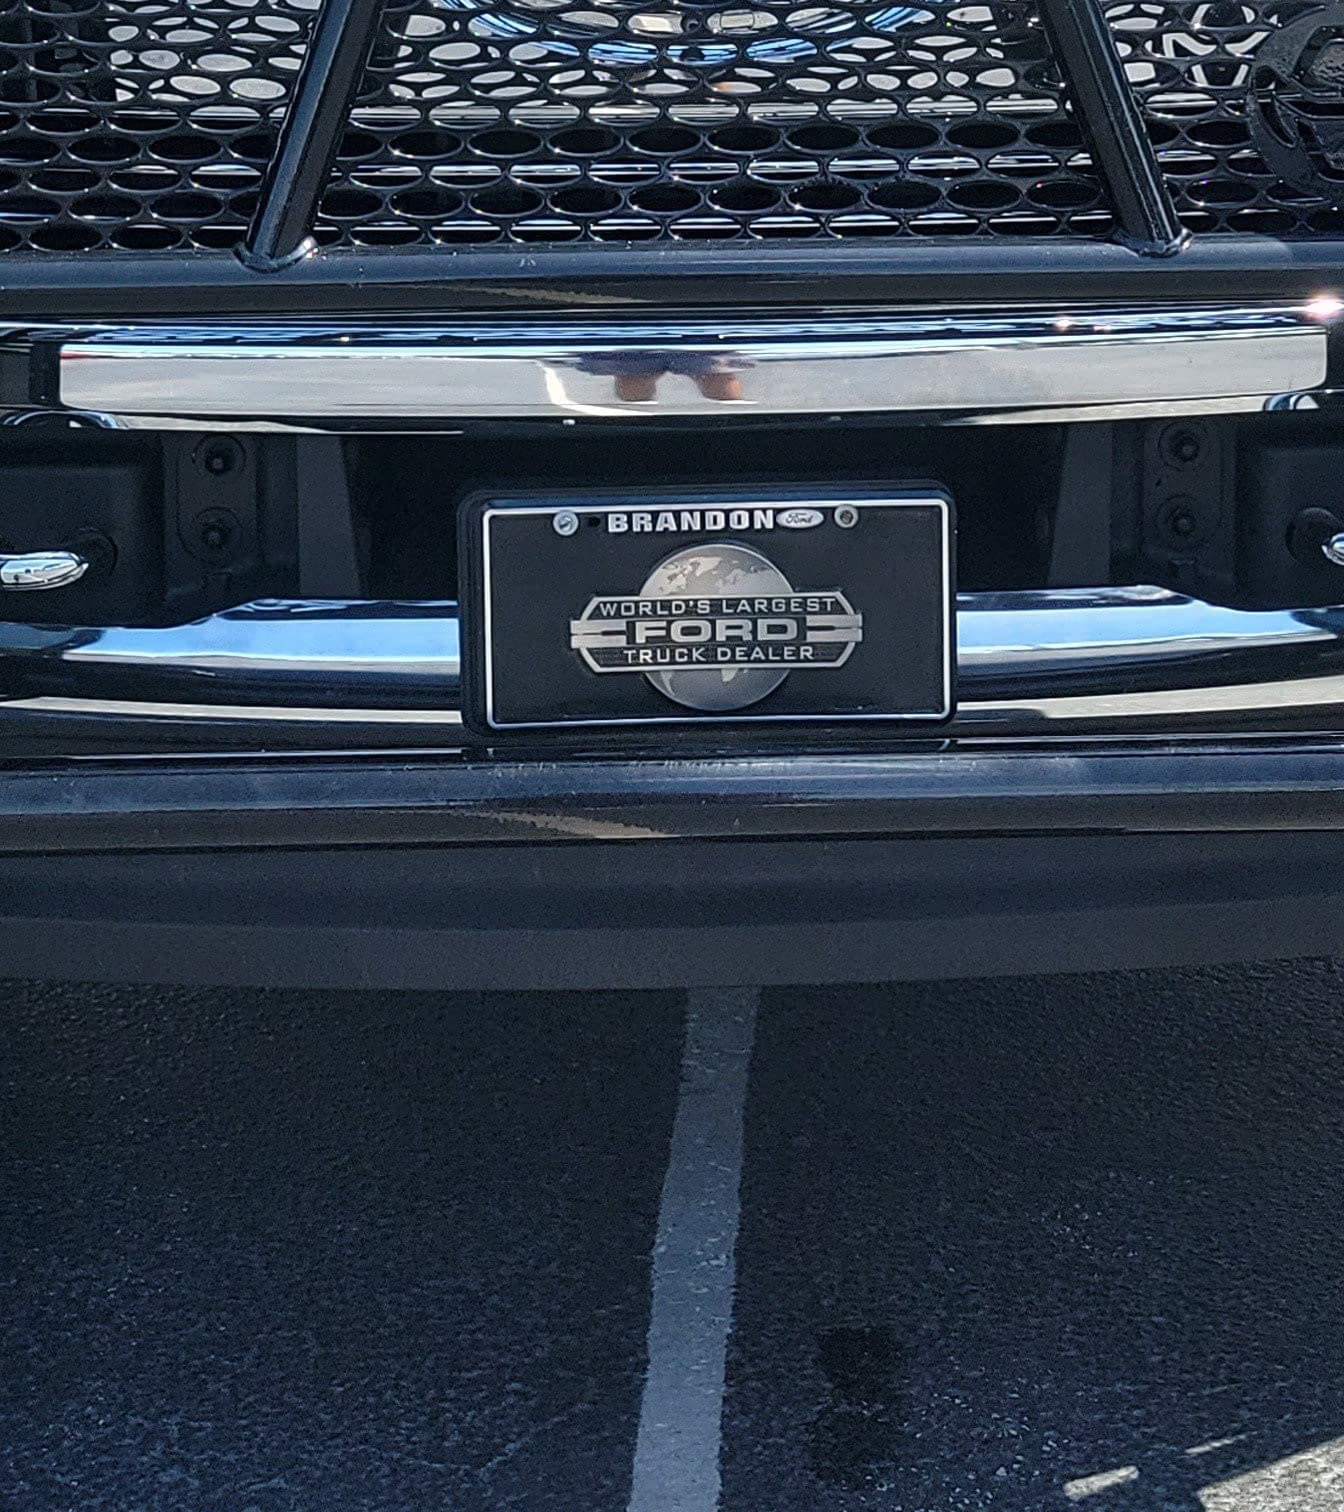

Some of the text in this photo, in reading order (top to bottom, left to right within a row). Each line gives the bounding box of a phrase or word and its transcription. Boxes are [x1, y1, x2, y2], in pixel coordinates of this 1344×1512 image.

[608, 509, 774, 533] BRANDON
[600, 596, 836, 616] WORLD'S LARGEST
[635, 618, 798, 644] FORD
[624, 645, 814, 664] TRUCK DEALER
